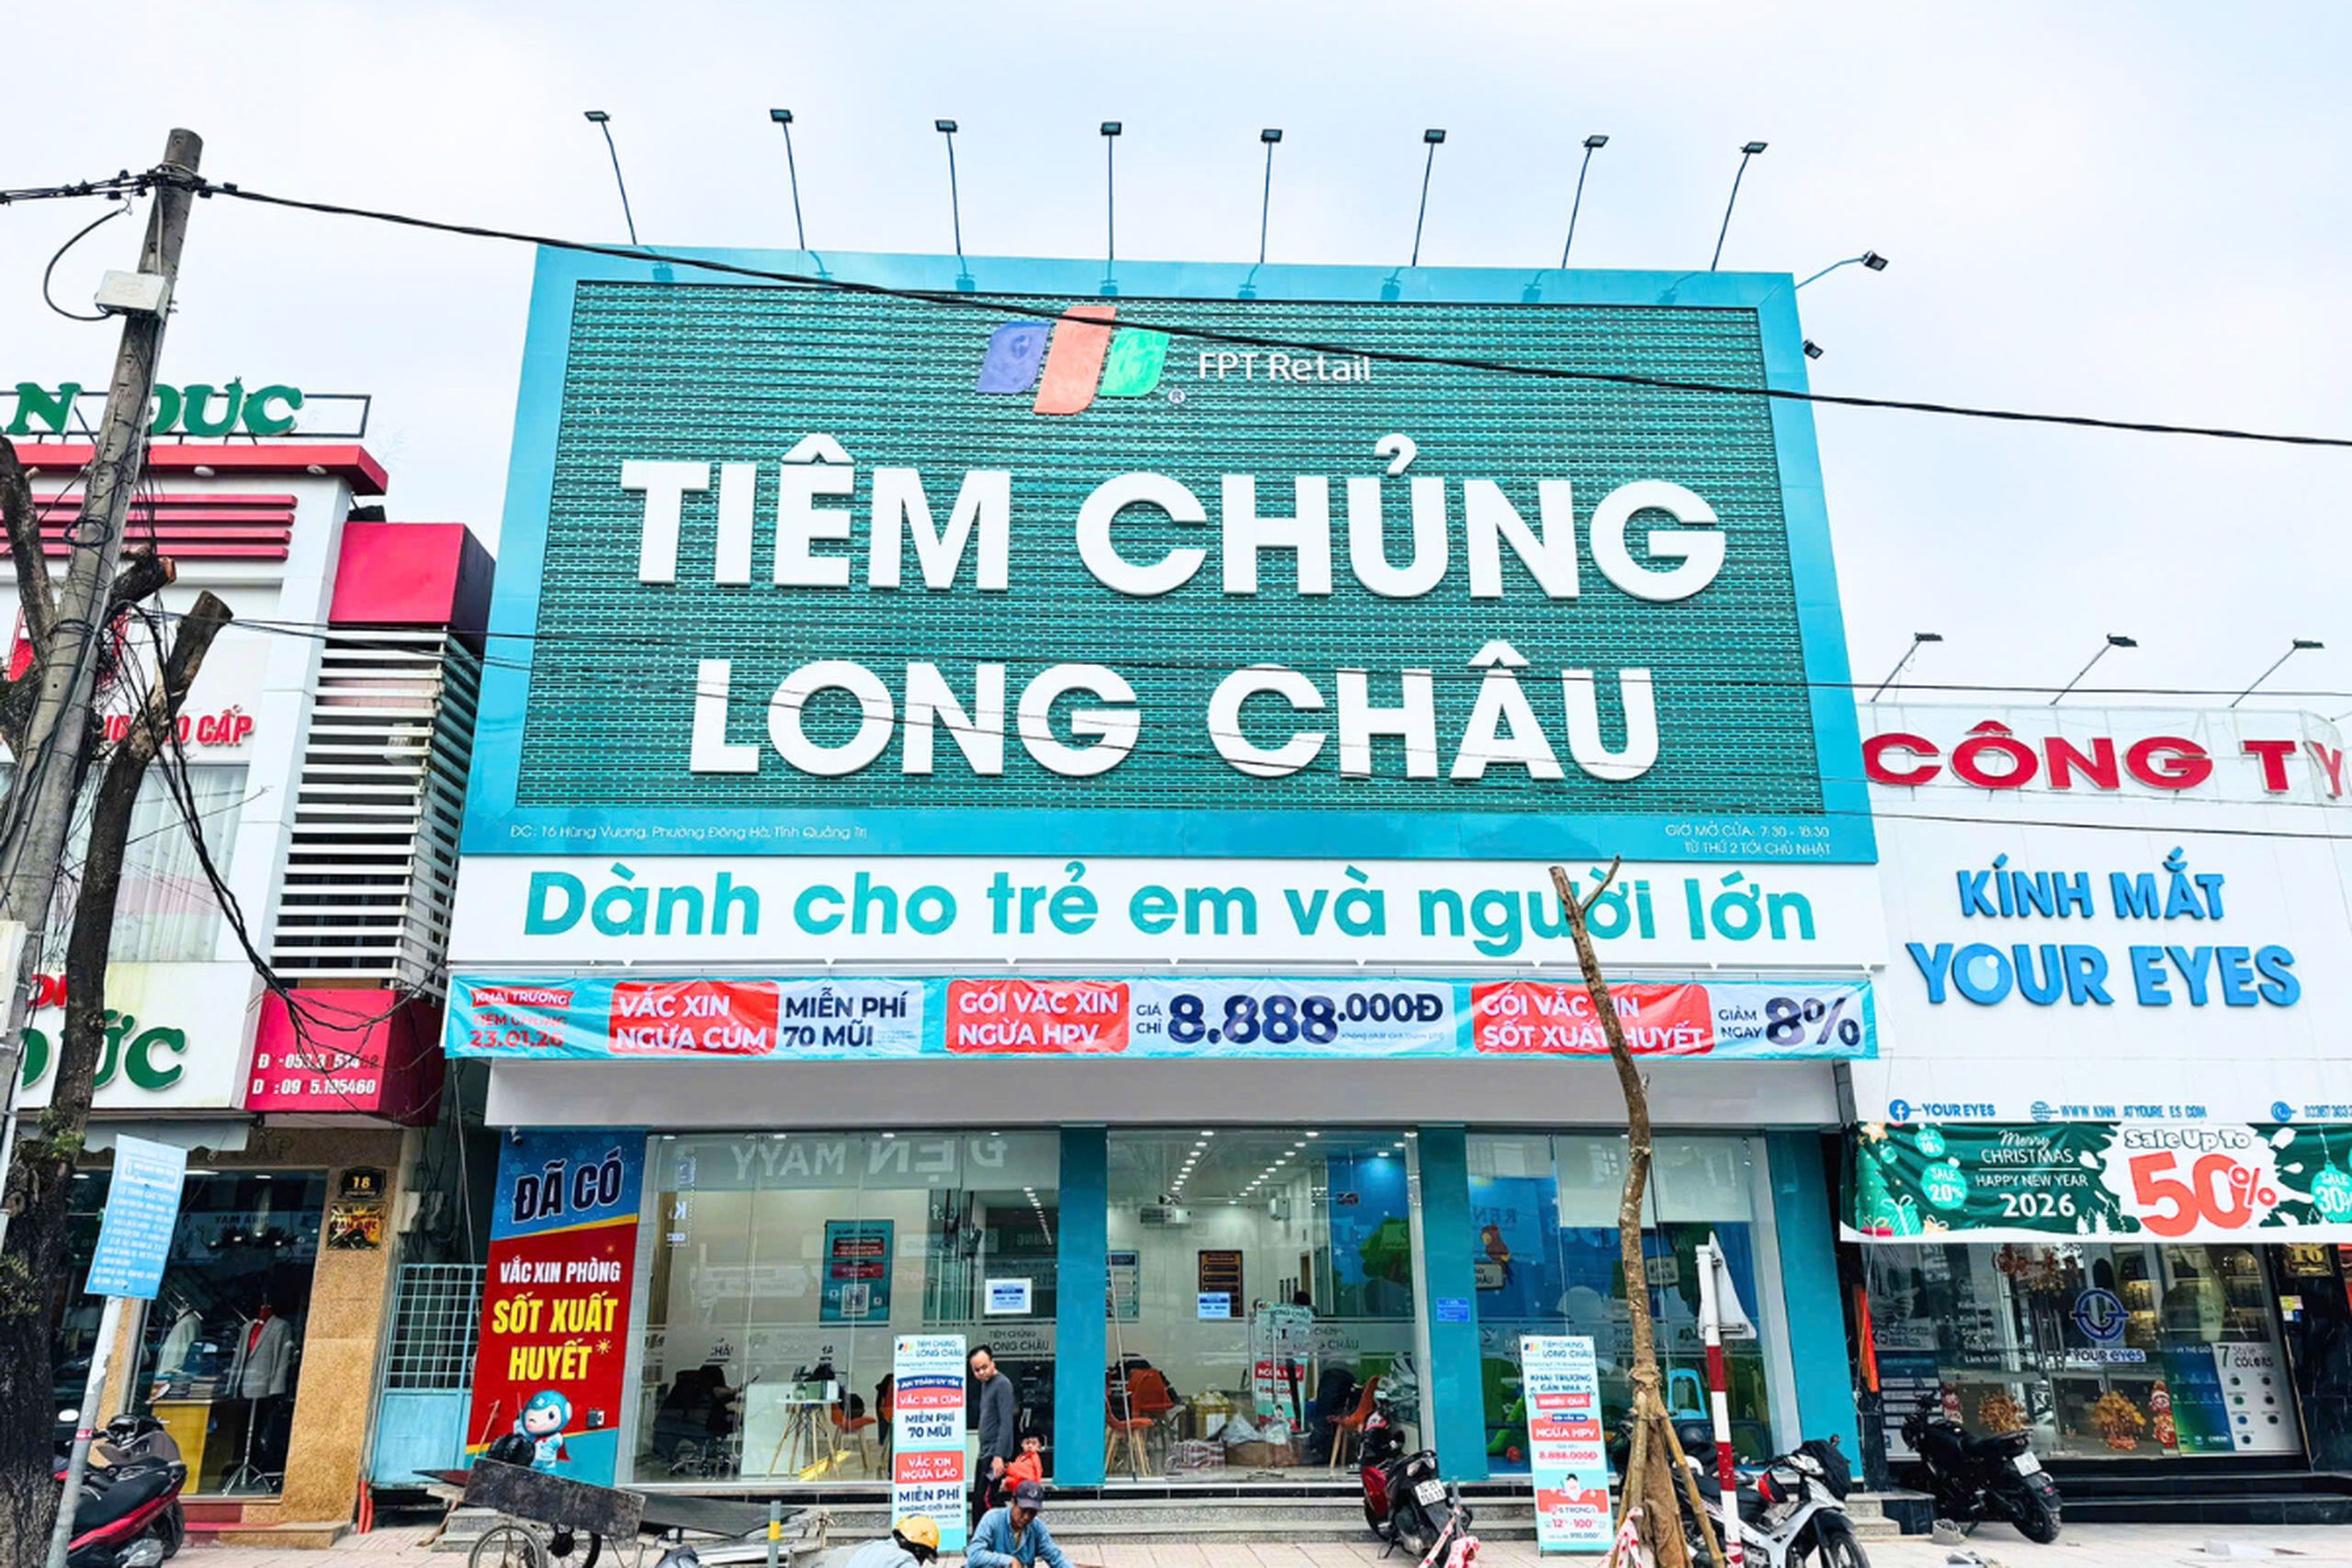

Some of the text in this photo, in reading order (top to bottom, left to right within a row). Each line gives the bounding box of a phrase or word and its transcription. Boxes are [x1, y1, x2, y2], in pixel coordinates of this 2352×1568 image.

[1199, 354, 1371, 382] FPT Retail
[0, 382, 81, 436] N
[621, 432, 1726, 602] TIÊM CHỦNG
[196, 704, 254, 745] CẤP
[689, 640, 1659, 781] LONG CHÂU
[1862, 720, 2343, 799] CÔNG TY
[1665, 822, 1691, 837] GIỜ
[1695, 820, 1720, 837] MỞ
[1684, 840, 1699, 853] TỪ
[1703, 840, 1727, 853] THỨ
[1730, 843, 1737, 853] 2
[1765, 840, 1793, 855] CHỦ
[1797, 842, 1831, 857] NHẬT
[1957, 845, 2225, 919] KÍNH MẮT
[525, 861, 1816, 957] Dành cho trẻ em và người lớn
[1905, 942, 2302, 1008] YOUR EYES
[475, 990, 568, 1006] KHAI TRƯƠNG
[618, 987, 731, 1020] VẮC XIN
[785, 987, 909, 1019] MIỄN PHÍ
[958, 983, 1119, 1014] GÓI VẮC XIN
[1136, 1001, 1162, 1017] GIÁ
[1481, 987, 1641, 1019] GÓI VẮC IN
[473, 1012, 508, 1027] TIÊM
[1136, 1019, 1162, 1035] CHỈ
[1718, 1005, 1758, 1021] GIẢM
[1765, 997, 1861, 1047] 8%
[469, 1030, 564, 1048] 23.01.26
[616, 1019, 769, 1051] NGỪA CÚM
[783, 1025, 816, 1048] 70
[822, 1019, 875, 1047] MŨI
[957, 1015, 1101, 1046] NGỪA HPV
[1485, 1018, 1705, 1050] SỐT XUẤT HUYẾT
[1721, 1025, 1763, 1039] NGAY
[1921, 1102, 1996, 1117] YOUR EYES
[1998, 1128, 2052, 1152] Merry
[2123, 1128, 2251, 1153] Sale Up To
[1981, 1147, 2075, 1165] CHRISTMAS
[512, 1145, 624, 1224] ĐÃ CÓ
[1929, 1168, 1957, 1182] SALE
[1975, 1174, 2089, 1187] HAPPY NEW YEAR
[1928, 1183, 1963, 1202] 20%
[1999, 1192, 2076, 1218] 2026
[2129, 1151, 2278, 1237] 50%
[499, 1255, 622, 1284] VẮC XIN PHÒNG
[492, 1291, 618, 1334] SỐT XUẤT
[508, 1337, 593, 1381] HUYẾT
[2072, 1348, 2108, 1361] YOUR
[2217, 1345, 2230, 1368] 7
[908, 1422, 952, 1438] 70 MŨI
[1571, 1428, 1596, 1438] HPV
[937, 1485, 961, 1500] PHÍ
